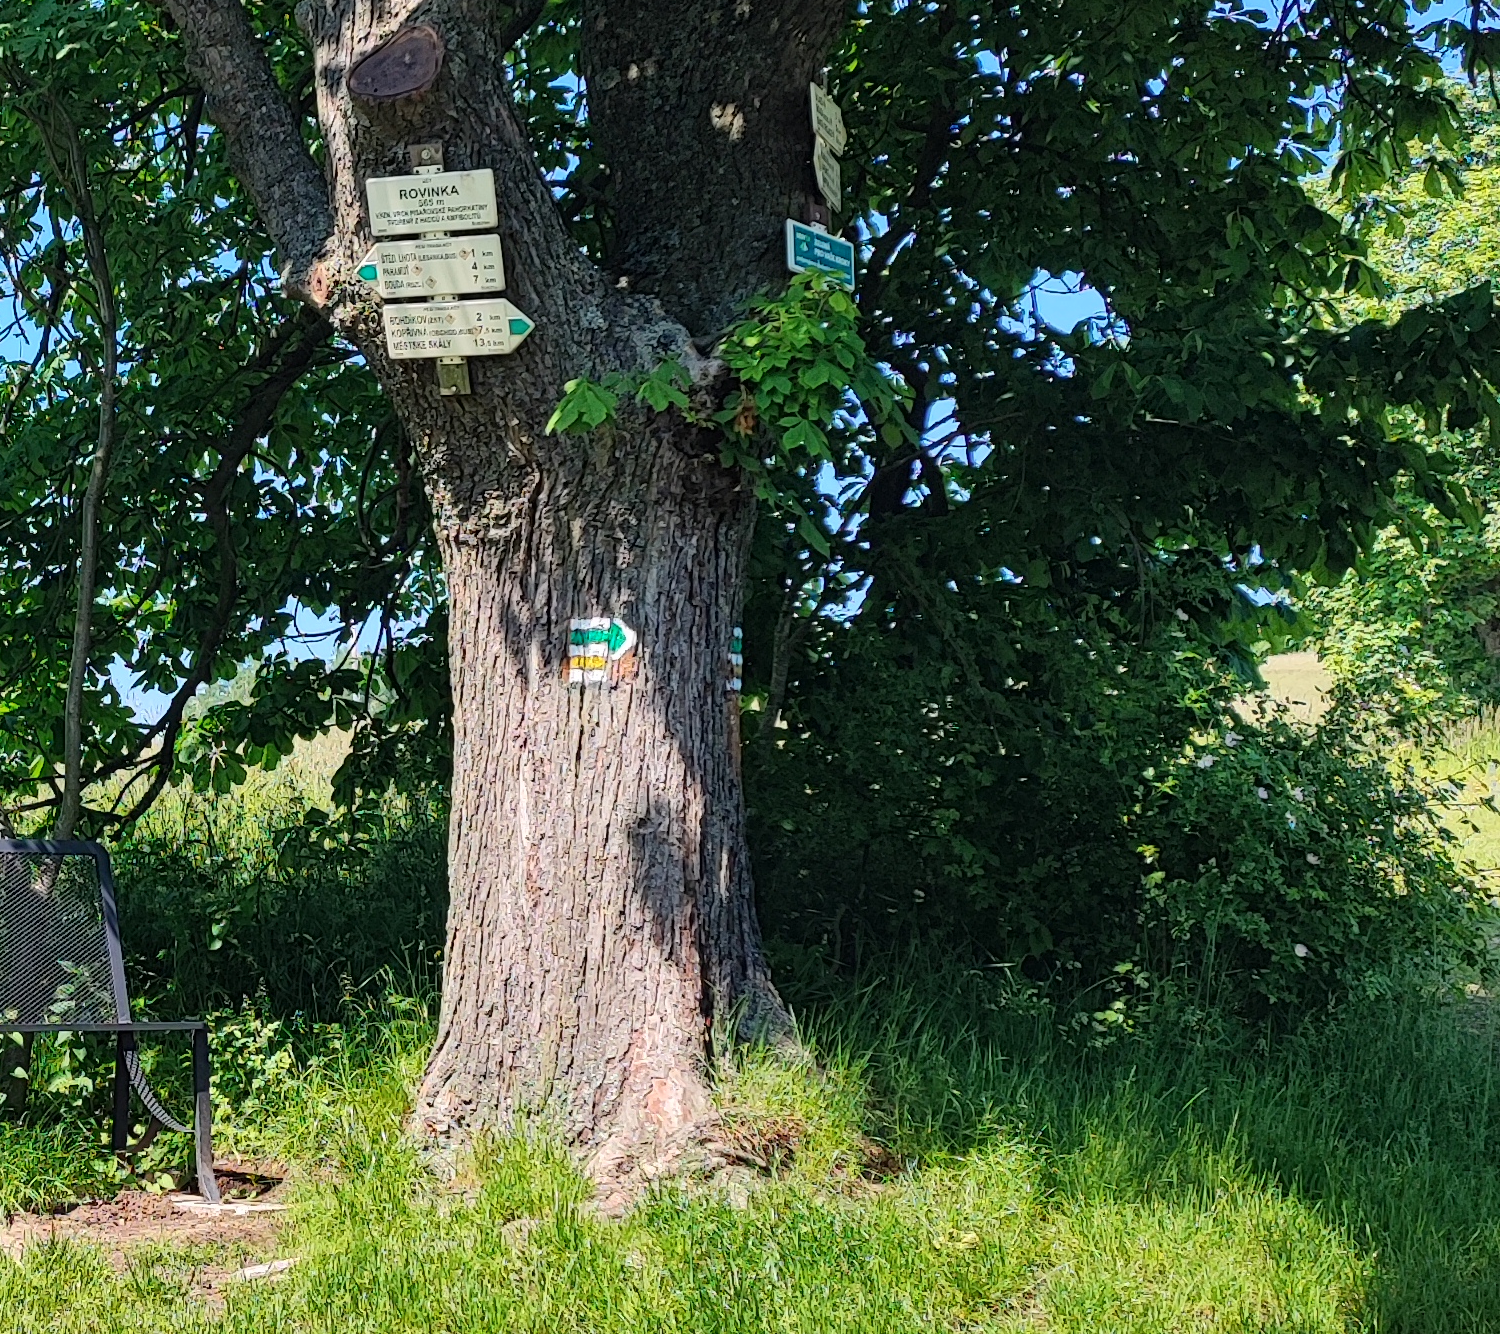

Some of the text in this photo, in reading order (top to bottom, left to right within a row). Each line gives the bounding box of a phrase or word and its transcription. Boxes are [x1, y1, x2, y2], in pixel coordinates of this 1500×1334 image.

[400, 185, 460, 199] ROVINKA
[471, 248, 475, 257] 1
[471, 261, 477, 270] 4
[472, 274, 479, 284] 7
[476, 312, 482, 321] 2
